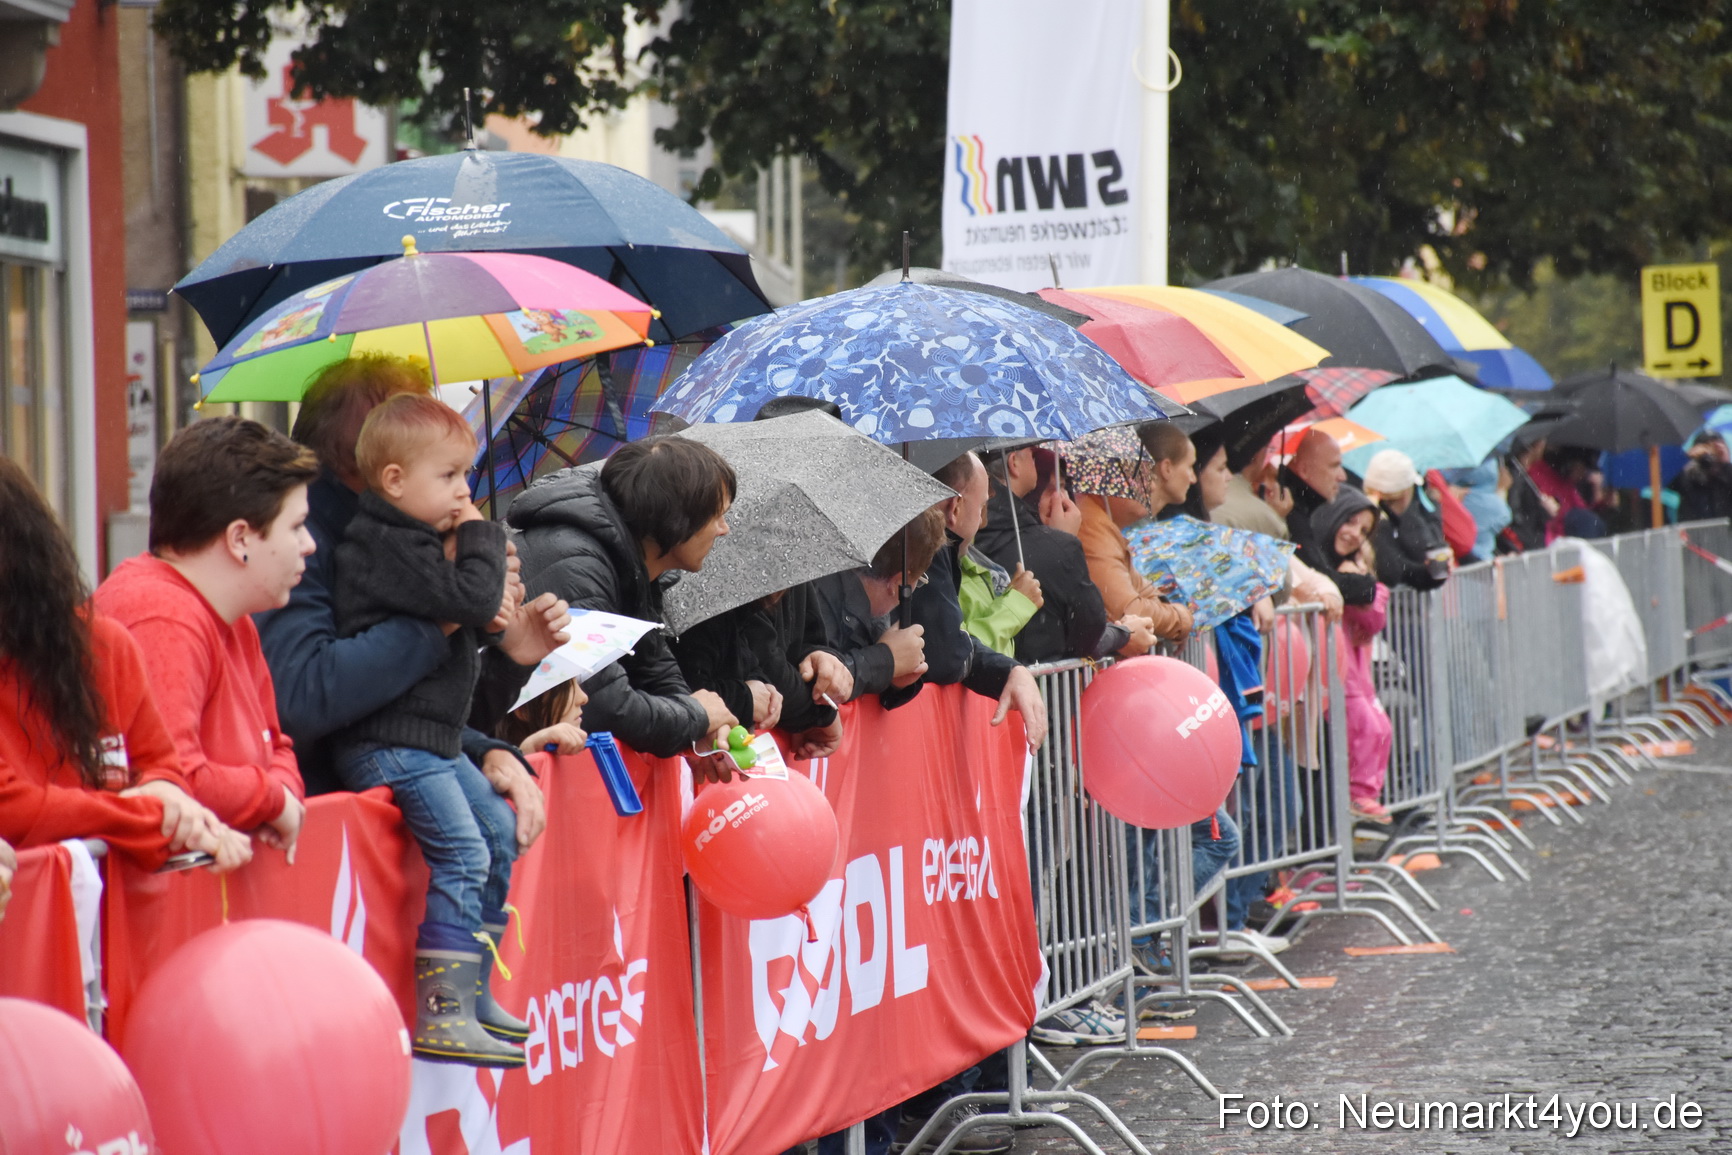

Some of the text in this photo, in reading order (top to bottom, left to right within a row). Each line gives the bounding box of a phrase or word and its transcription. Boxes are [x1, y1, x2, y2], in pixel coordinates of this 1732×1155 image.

[405, 197, 512, 217] Fischer
[414, 212, 502, 223] AUTOMOBILE
[1652, 270, 1709, 292] Block
[1665, 301, 1700, 351] D
